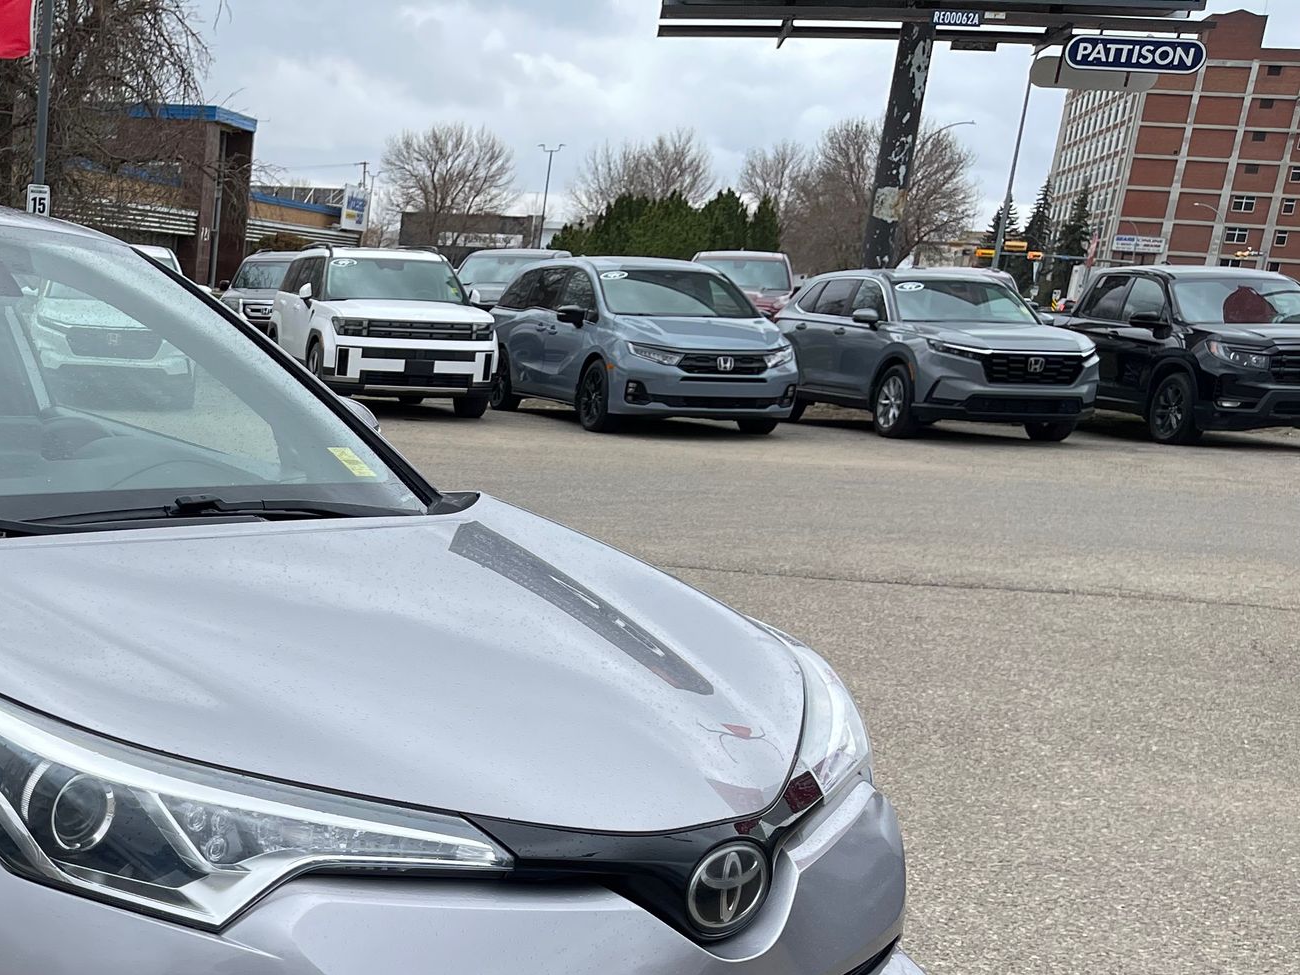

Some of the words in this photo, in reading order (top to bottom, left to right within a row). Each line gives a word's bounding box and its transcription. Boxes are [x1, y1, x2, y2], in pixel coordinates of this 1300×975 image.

[933, 11, 979, 25] RE00062A
[1076, 42, 1195, 66] PATTISON
[31, 197, 46, 214] 15
